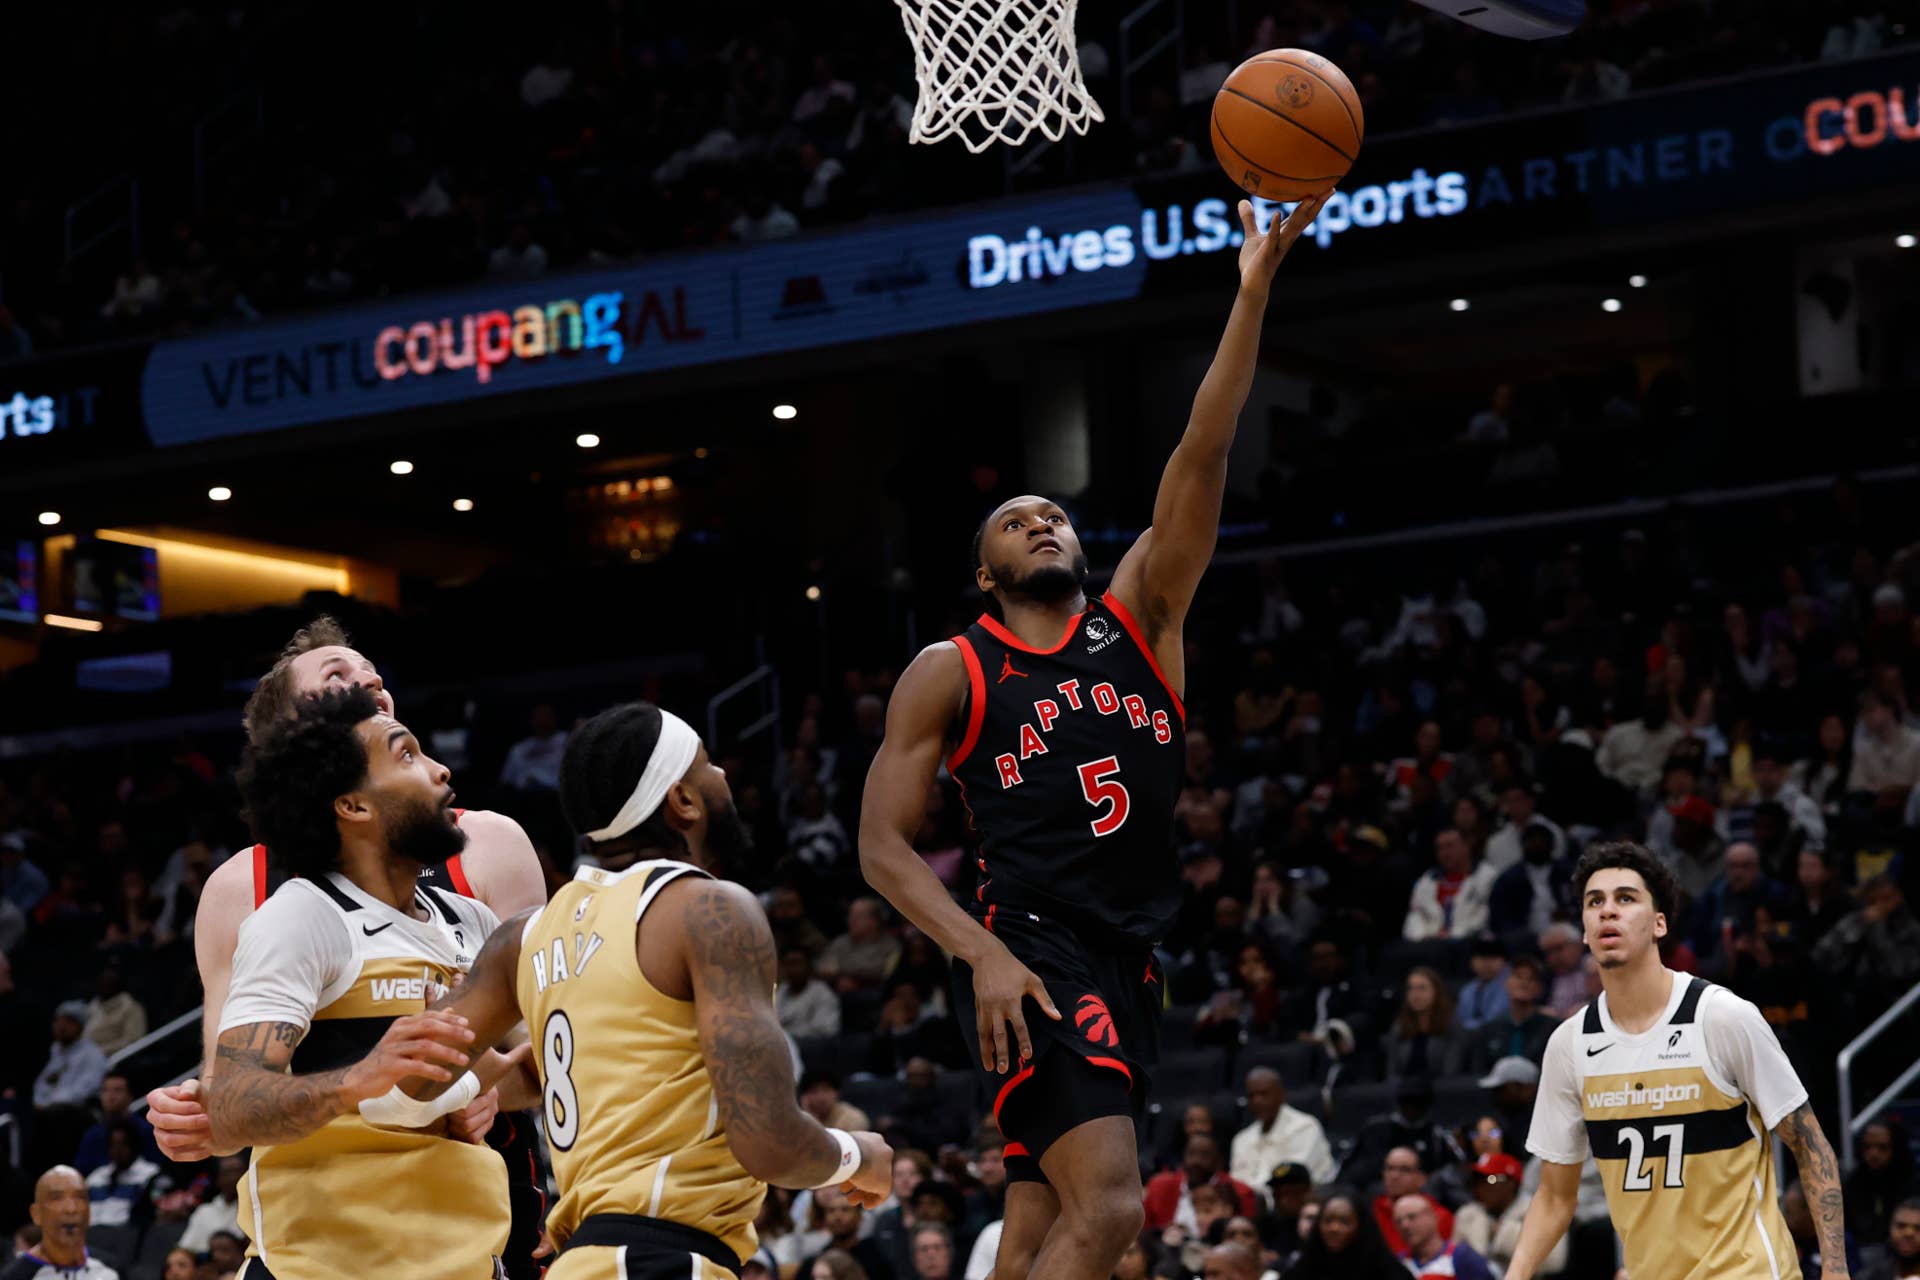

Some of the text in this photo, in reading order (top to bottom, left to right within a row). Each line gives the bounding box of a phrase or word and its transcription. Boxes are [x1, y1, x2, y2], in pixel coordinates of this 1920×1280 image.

[1477, 129, 1732, 208] ARTNER
[968, 224, 1136, 289] Drives
[1141, 198, 1243, 260] U.S.
[201, 337, 380, 411] VENTU
[374, 291, 625, 384] coupang
[1087, 630, 1121, 655] Sun Life
[995, 678, 1171, 789] RAPTORS
[1077, 755, 1130, 837] 5
[542, 1008, 580, 1152] 8
[1587, 1081, 1700, 1111] washington
[1617, 1123, 1686, 1192] 27
